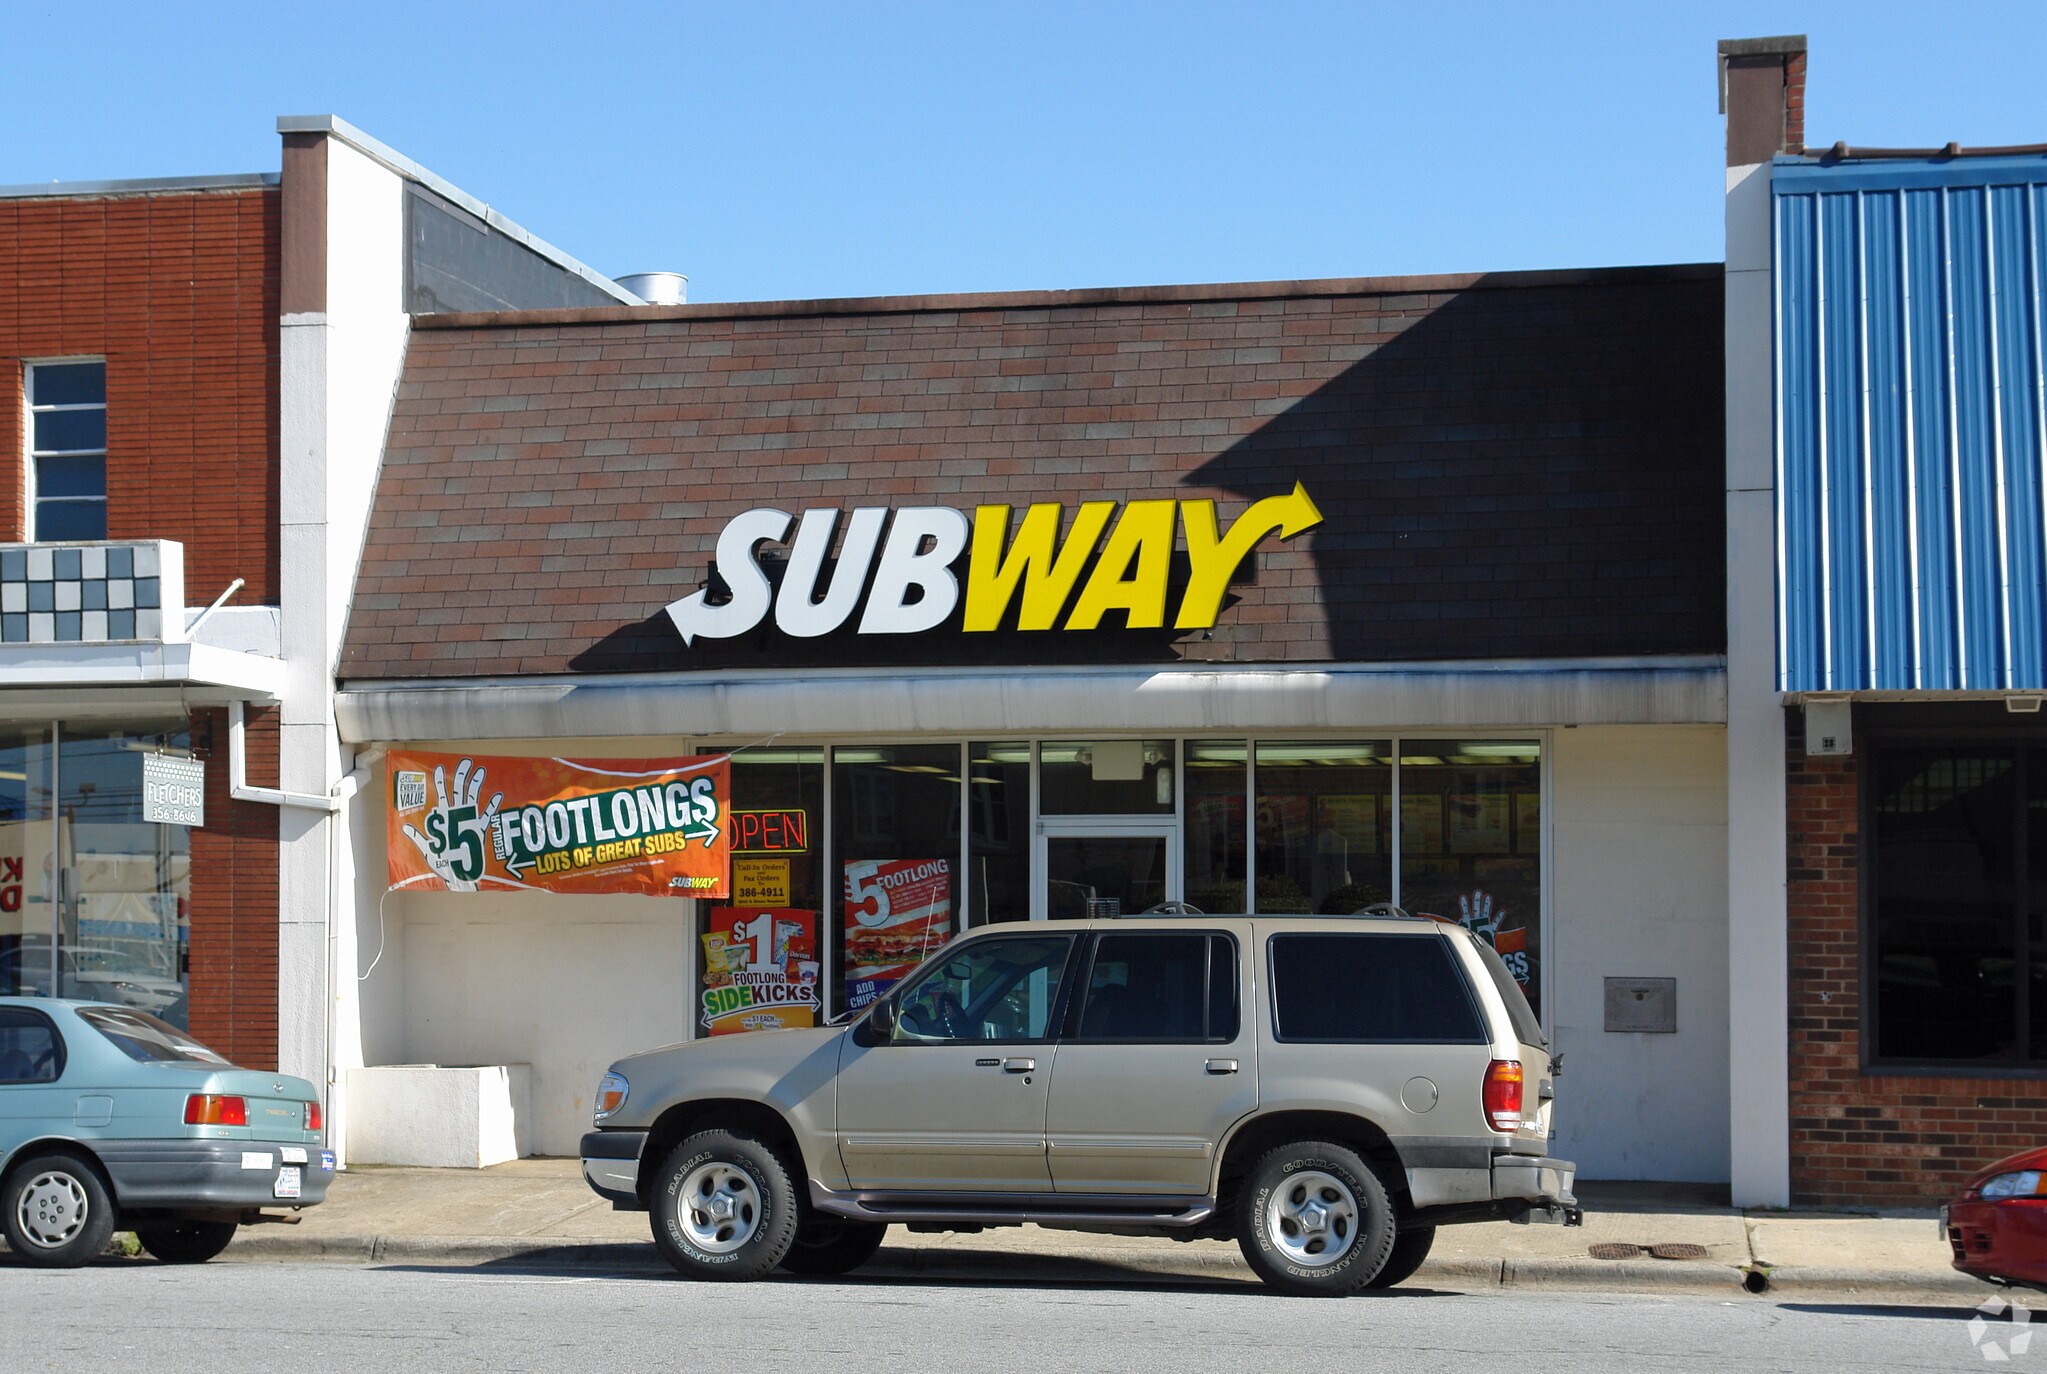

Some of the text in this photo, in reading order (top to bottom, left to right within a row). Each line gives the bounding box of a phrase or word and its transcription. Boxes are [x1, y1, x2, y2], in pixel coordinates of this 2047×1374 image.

[665, 480, 1326, 648] SUBWAY
[147, 781, 201, 807] FLETCHERS
[400, 783, 417, 791] EVERY
[400, 792, 424, 808] VALUE
[500, 778, 717, 857] FOOTLONGS
[730, 812, 804, 850] OPEN
[426, 805, 484, 882] $5
[490, 813, 506, 861] REGULAR
[535, 851, 572, 875] LOTS
[573, 846, 594, 868] OF
[596, 838, 642, 865] GREAT
[645, 831, 687, 855] SUBS
[436, 859, 450, 869] EACH
[668, 876, 719, 888] SUBWAY
[876, 859, 949, 892] FOOTLONG
[739, 887, 784, 897] 386-4911
[733, 914, 781, 973] $1
[734, 972, 785, 985] FOOTLONG
[856, 980, 875, 995] ADD
[705, 984, 812, 1016] SIDEKICKS
[850, 991, 878, 1008] CHIPS
[668, 1151, 713, 1195] RADIAL
[1283, 1158, 1368, 1209] GOODYEAR
[1254, 1187, 1270, 1252] RADIAL
[667, 1219, 739, 1264] WRANGLER
[1287, 1233, 1368, 1278] WRANGLER
